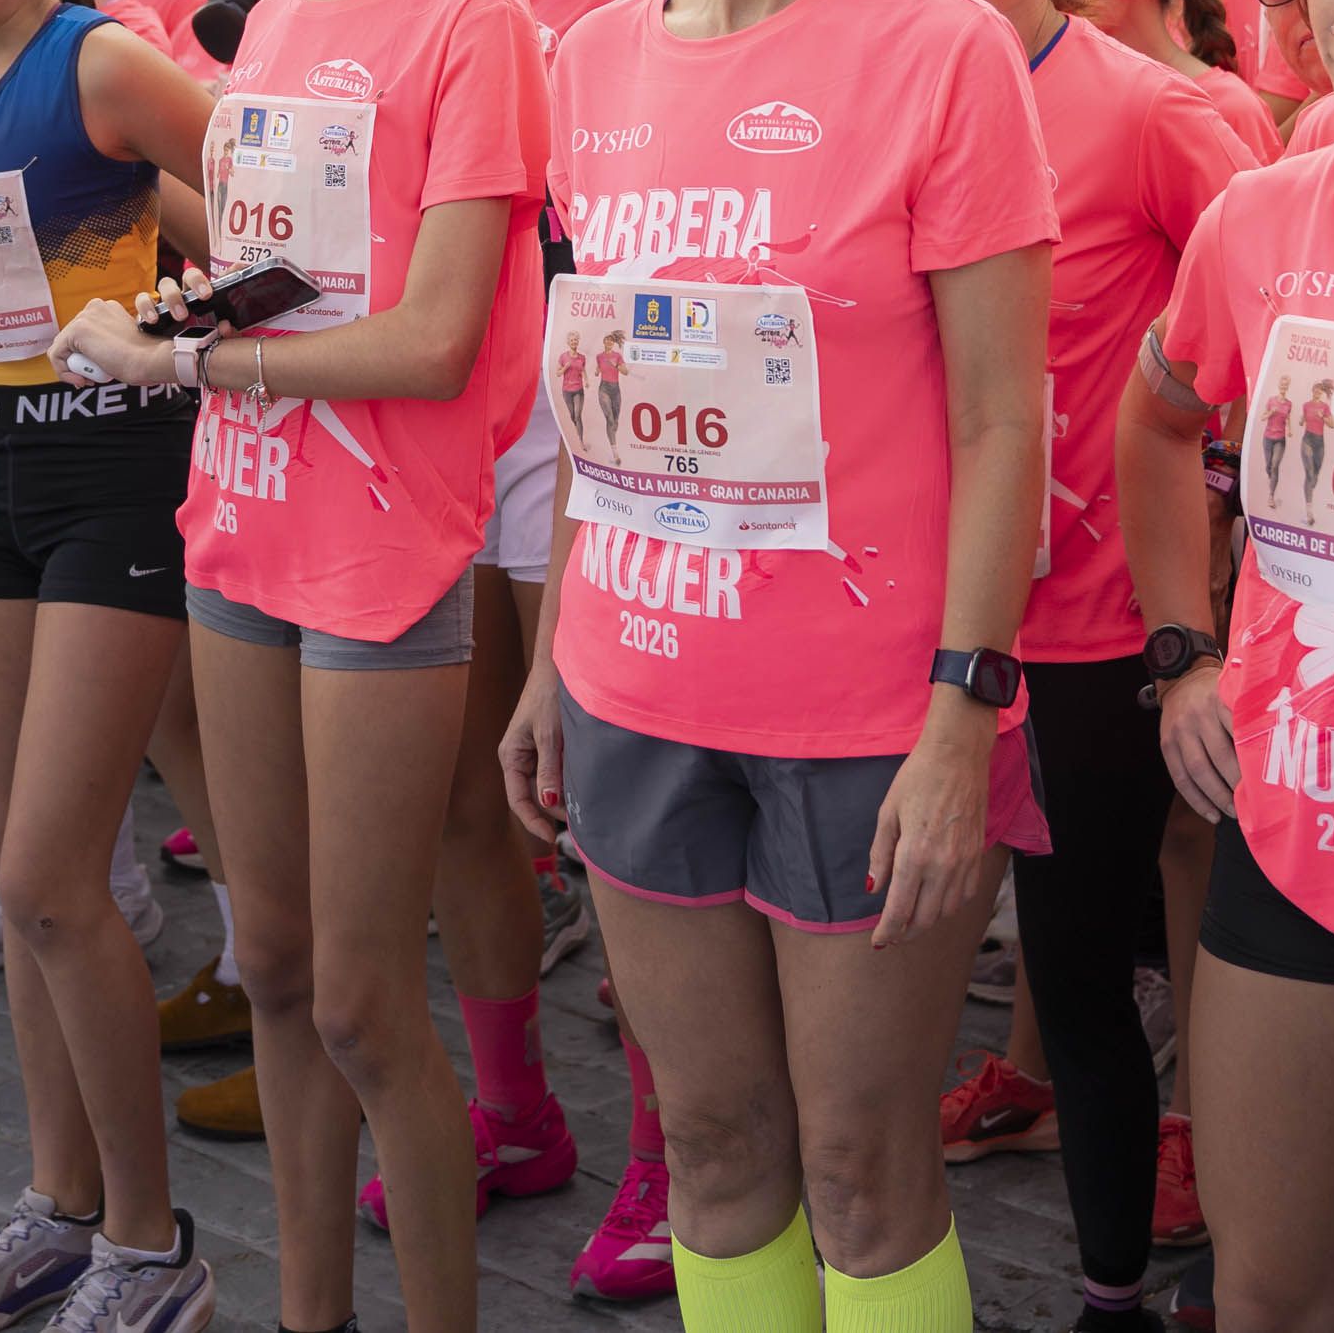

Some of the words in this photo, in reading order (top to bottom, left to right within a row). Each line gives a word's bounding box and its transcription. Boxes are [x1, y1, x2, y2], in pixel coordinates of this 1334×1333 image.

[310, 70, 367, 97] ASTURIANA
[571, 123, 652, 154] OYSHO
[733, 121, 814, 144] ASTURIANA
[228, 199, 293, 241] 016
[571, 187, 771, 263] CARRERA
[240, 245, 272, 262] 2572
[316, 276, 357, 291] ANARIA
[570, 291, 581, 301] TU
[305, 307, 345, 317] Santander
[570, 301, 616, 319] SUMA
[3, 338, 39, 349] Santander
[1303, 335, 1331, 350] DORSAL
[1287, 345, 1329, 367] SUMA
[16, 383, 128, 424] NIKE
[631, 402, 729, 449] 016
[664, 455, 698, 474] 765
[578, 461, 620, 484] CARRERA
[621, 476, 635, 489] DE
[638, 478, 653, 492] LA
[657, 480, 699, 496] MUJER
[709, 484, 744, 501] GRAN
[748, 487, 810, 501] CANARIA
[215, 499, 237, 535] 26
[596, 495, 633, 516] OYSHO
[659, 510, 706, 529] ASTURIANA
[750, 520, 797, 531] Santander
[1254, 523, 1307, 550] CARRERA
[1310, 538, 1326, 554] DE
[581, 522, 742, 619] MUJER
[1271, 563, 1312, 587] OYSHO
[619, 610, 679, 660] 2026
